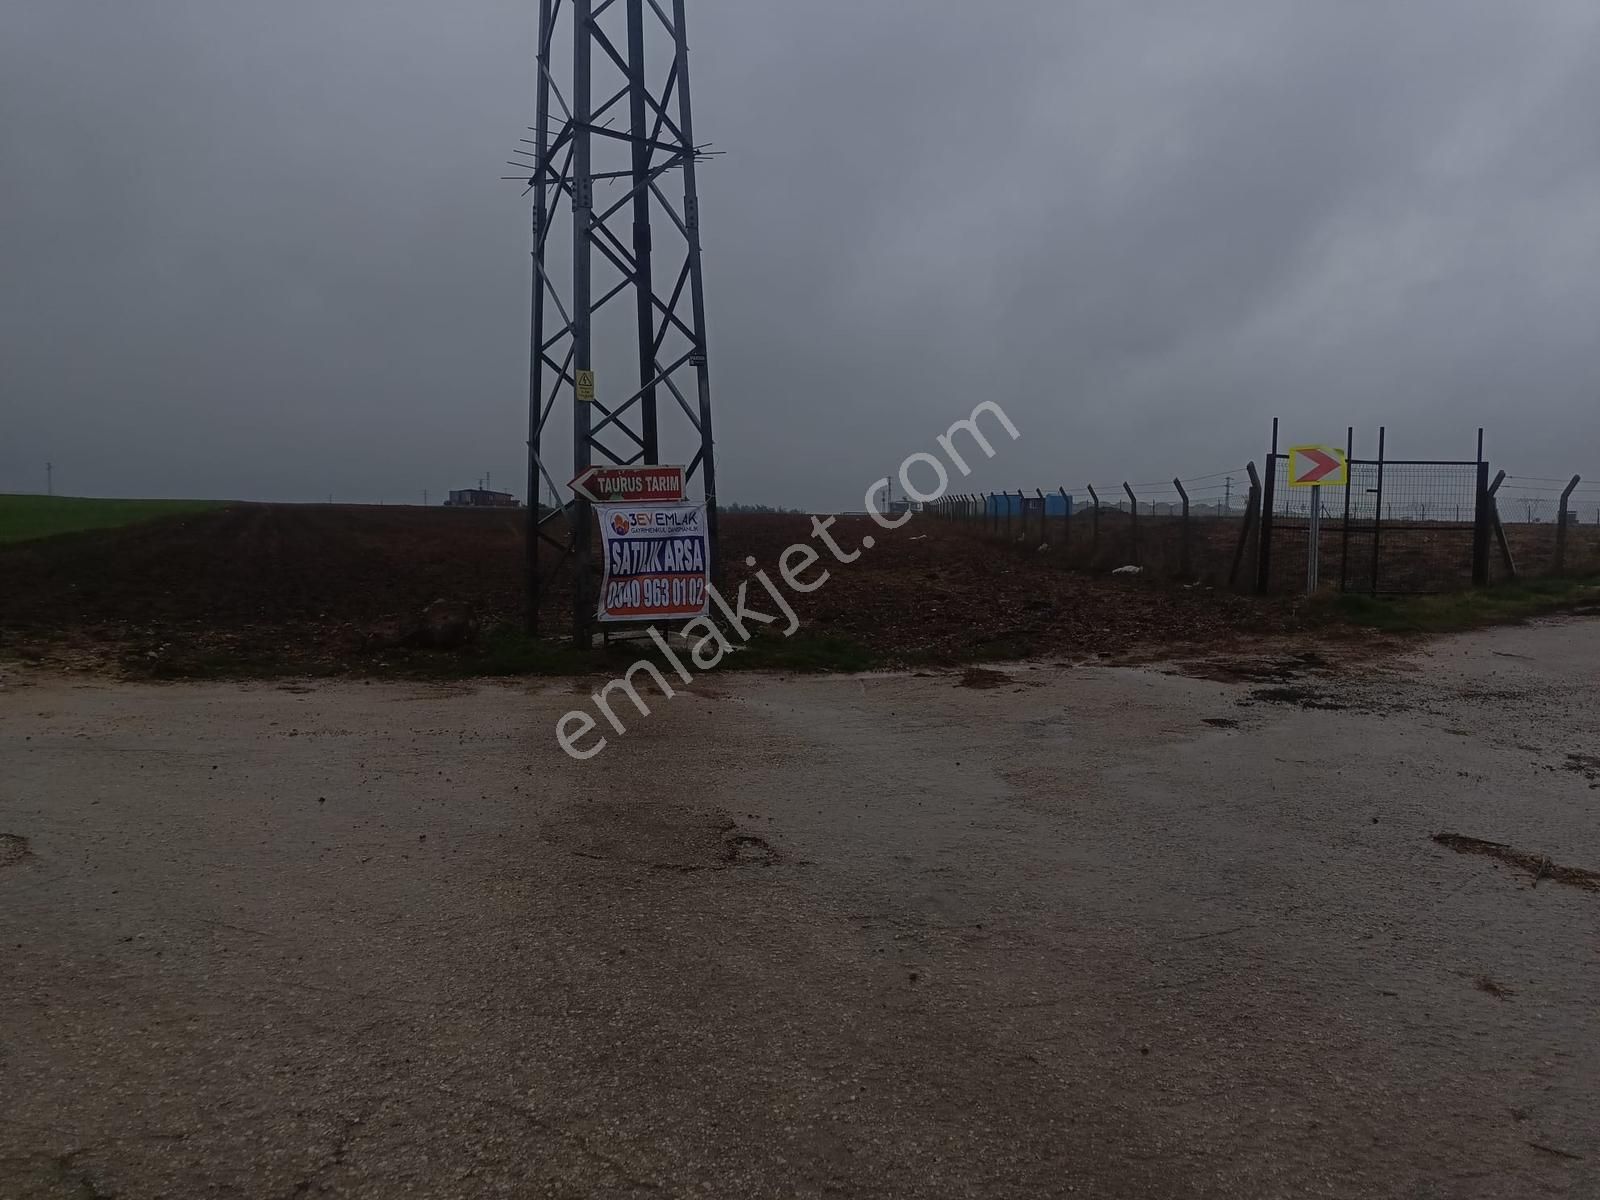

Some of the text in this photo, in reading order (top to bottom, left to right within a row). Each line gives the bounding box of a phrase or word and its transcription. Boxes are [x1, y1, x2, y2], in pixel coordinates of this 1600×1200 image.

[598, 475, 679, 493] TAURUS TARIM
[655, 511, 697, 526] EMLAK
[612, 539, 703, 575] SATILIK ARSA
[607, 577, 704, 609] 0540 963 01 02
